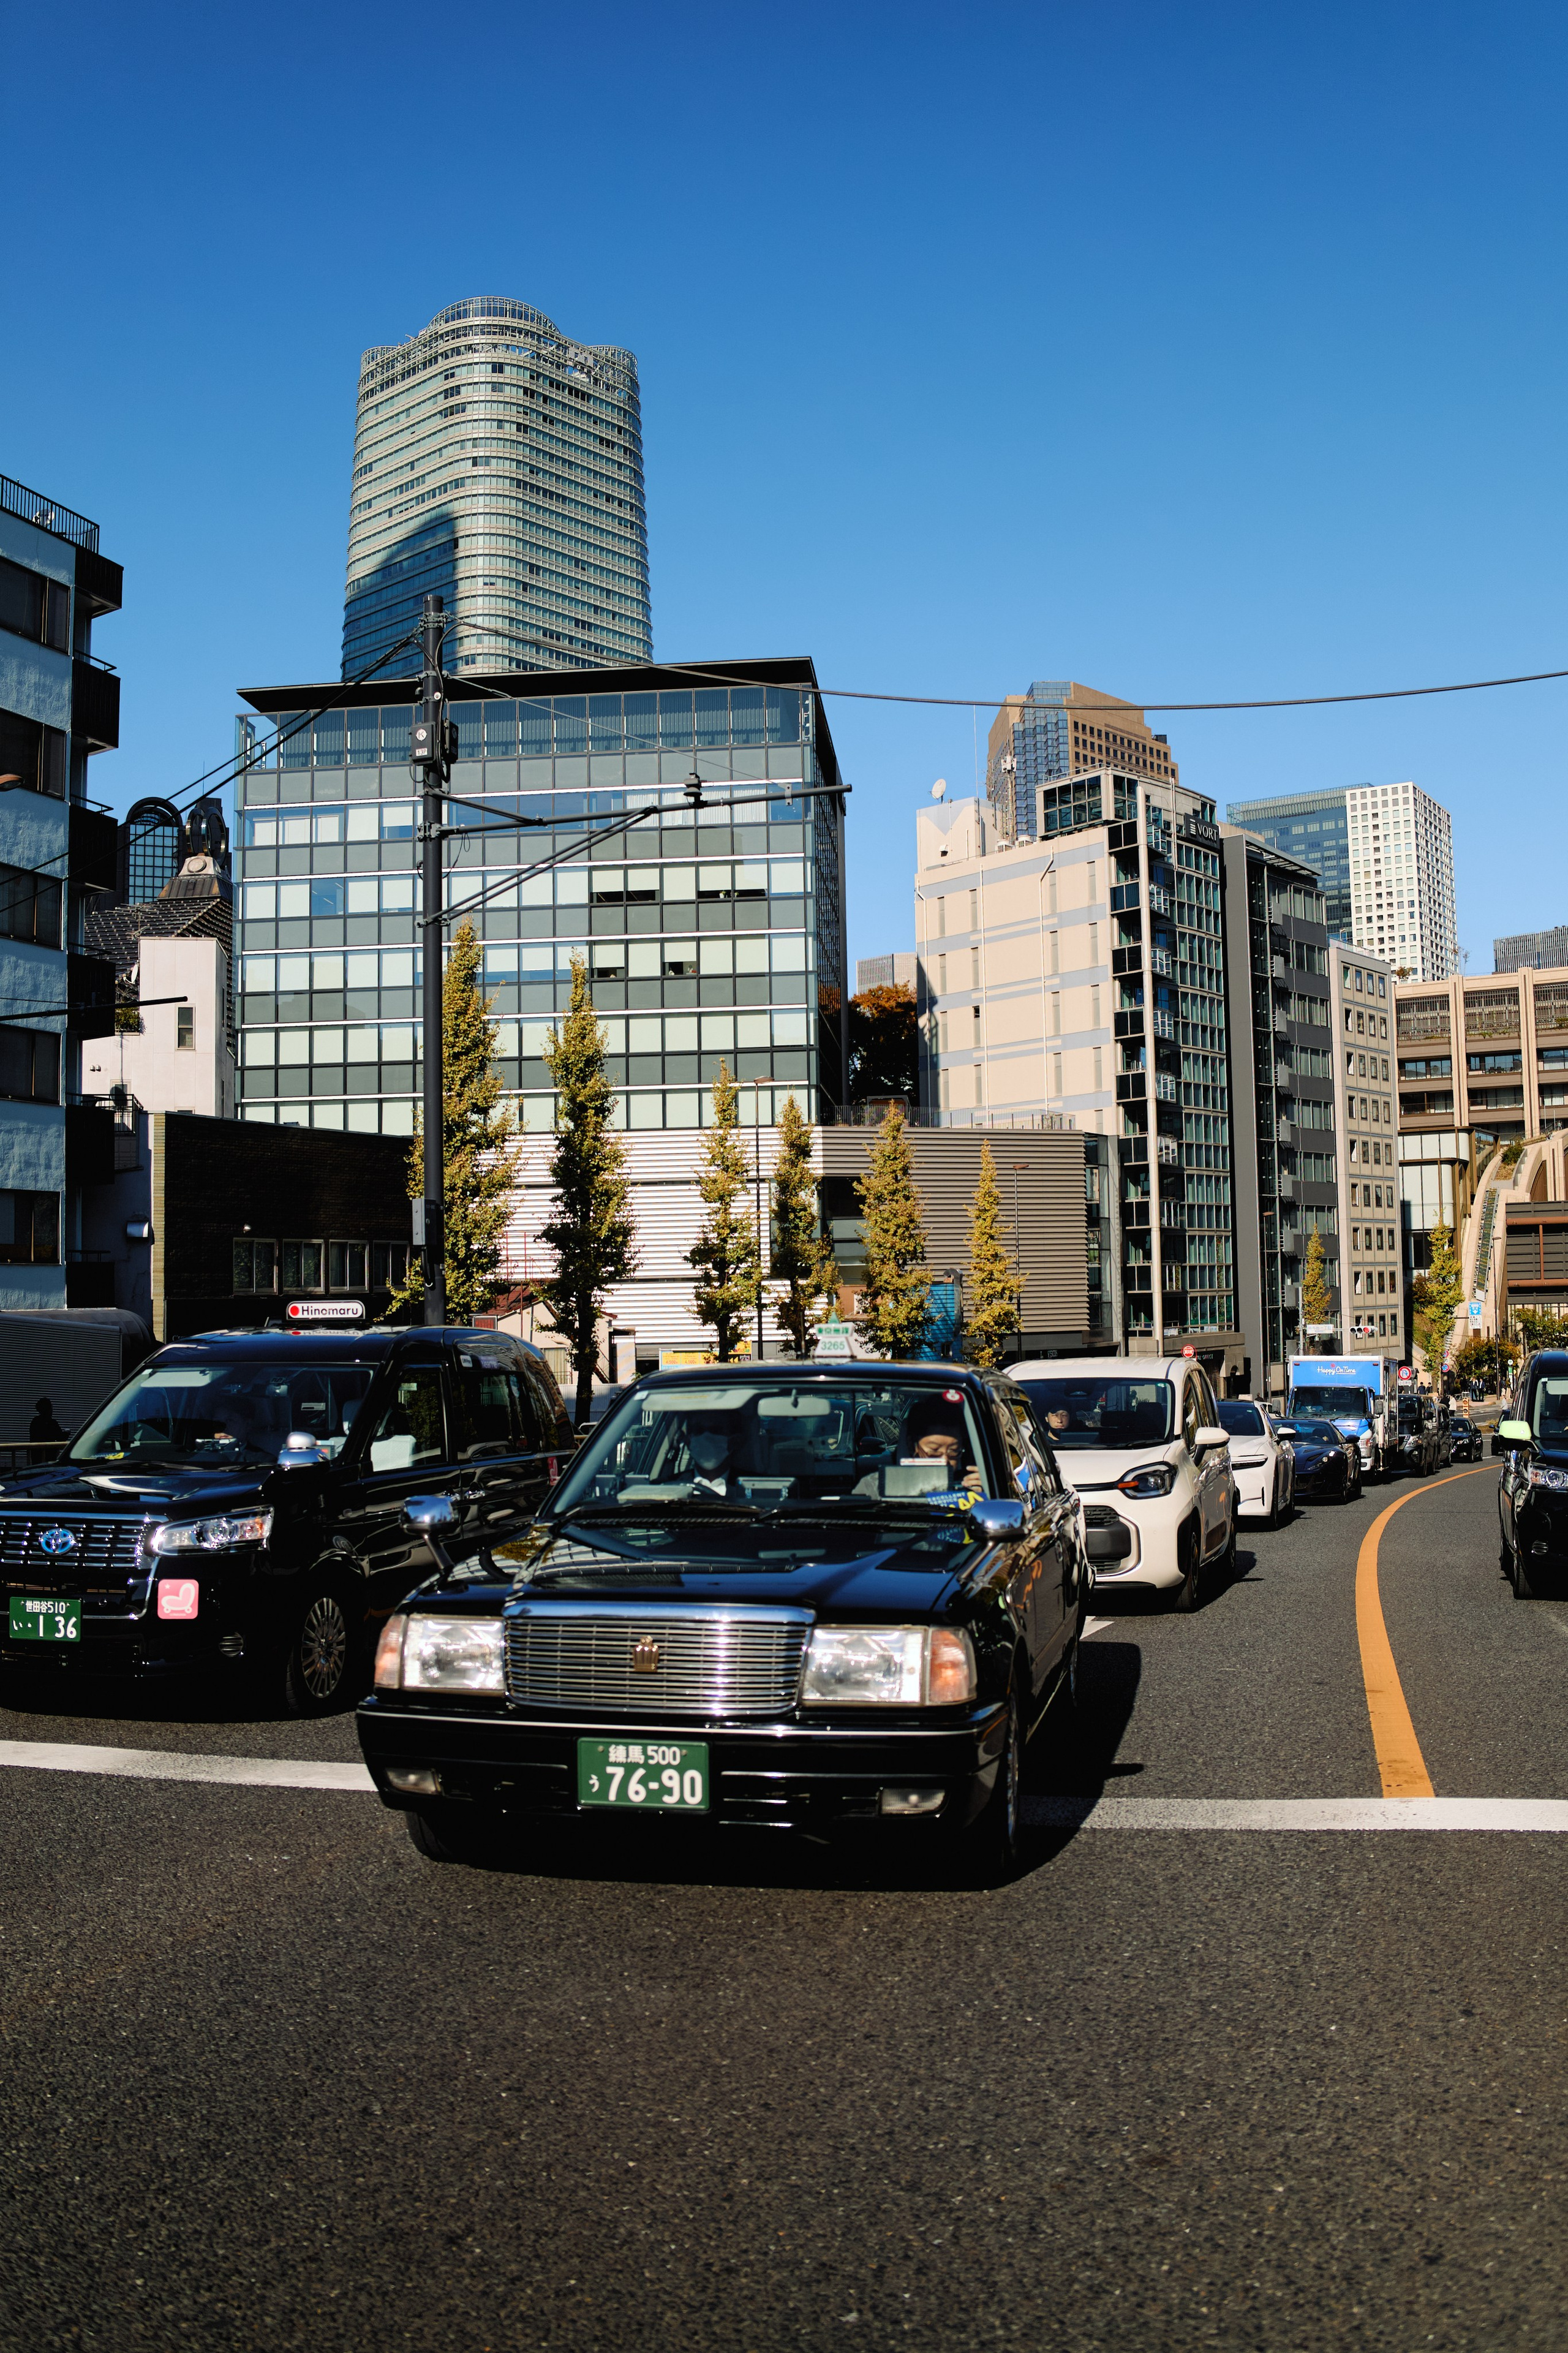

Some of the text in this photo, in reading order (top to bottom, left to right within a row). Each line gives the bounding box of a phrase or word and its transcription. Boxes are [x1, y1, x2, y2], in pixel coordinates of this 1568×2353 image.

[1197, 823, 1218, 841] VORT
[301, 1305, 358, 1316] Hinomaru
[821, 1341, 845, 1351] 3265
[1317, 1365, 1335, 1375] Happy
[927, 1492, 966, 1502] EXCELLENT
[608, 1744, 681, 1766] 練馬 500
[605, 1766, 703, 1805] 76-90
